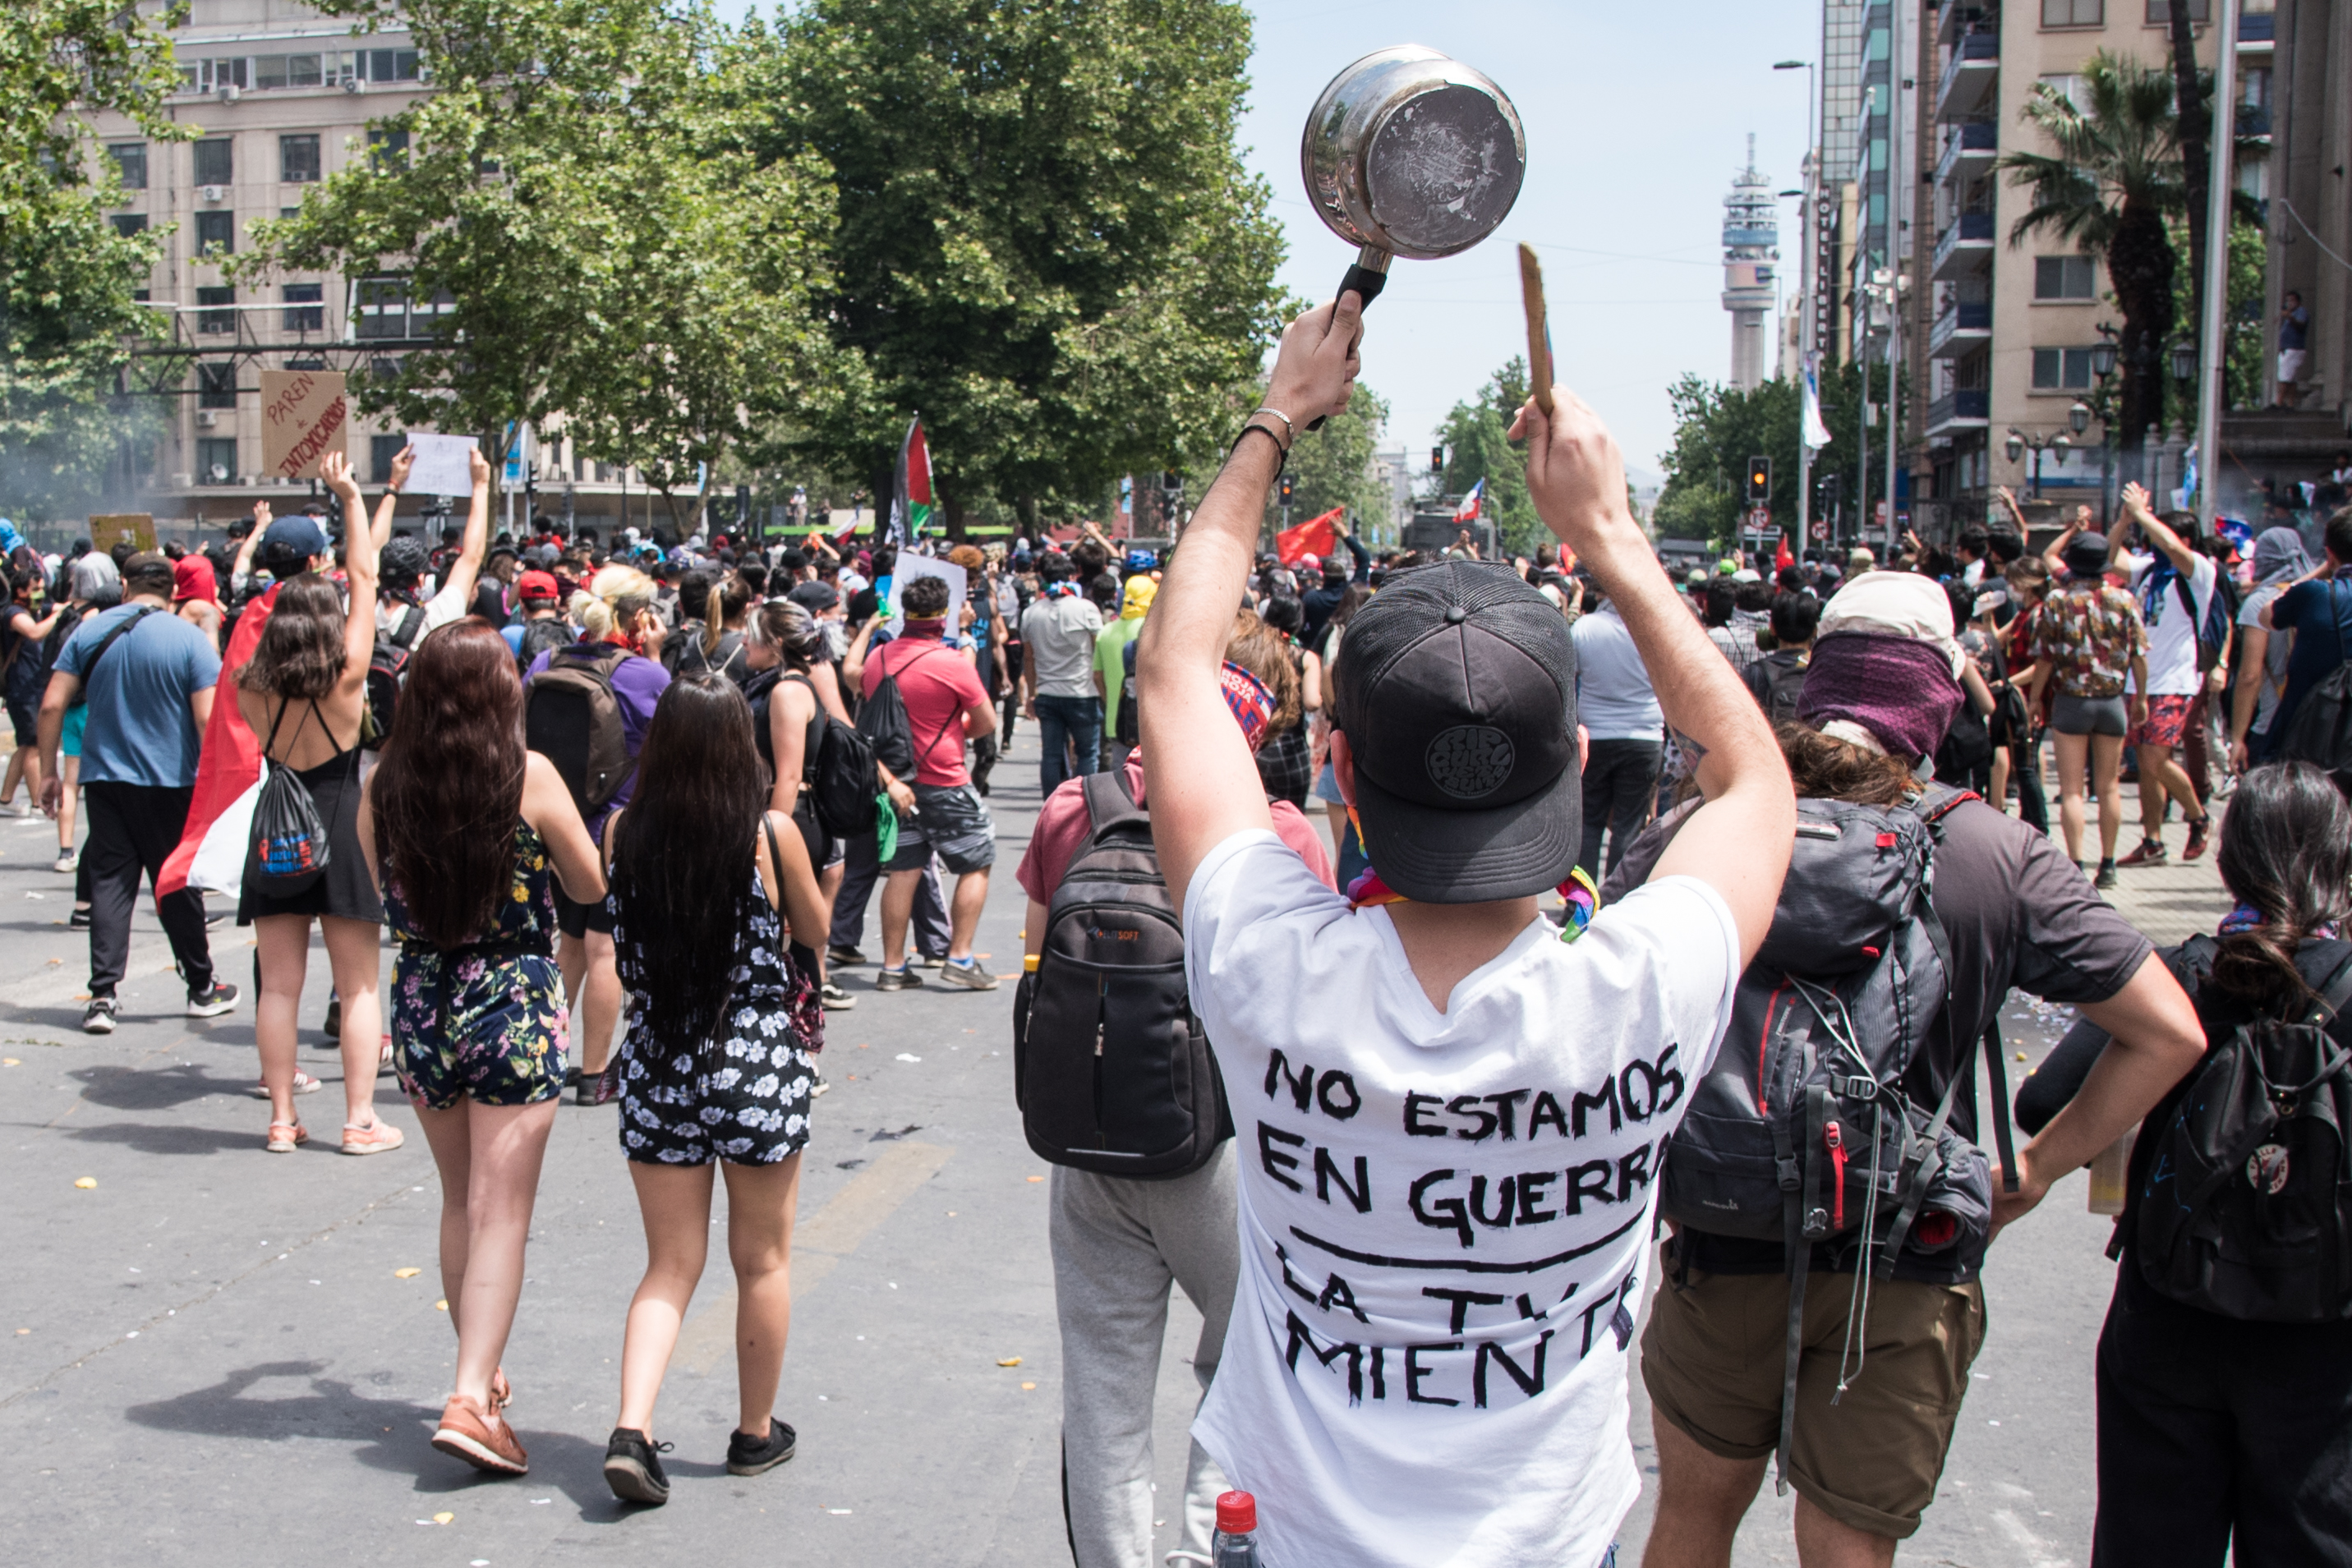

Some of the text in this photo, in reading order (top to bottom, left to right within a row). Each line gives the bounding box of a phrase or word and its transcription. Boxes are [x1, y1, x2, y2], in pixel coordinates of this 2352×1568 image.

[1816, 187, 1830, 348] HOTEL LIBERT
[267, 373, 315, 426] PAREN
[1429, 743, 1512, 768] CURL
[1434, 728, 1502, 752] RIP
[1263, 1042, 1685, 1143] NO ESTAMOS
[1257, 1119, 1372, 1214] EN
[1273, 1239, 1371, 1325] LA
[1284, 1273, 1634, 1409] MIENT
